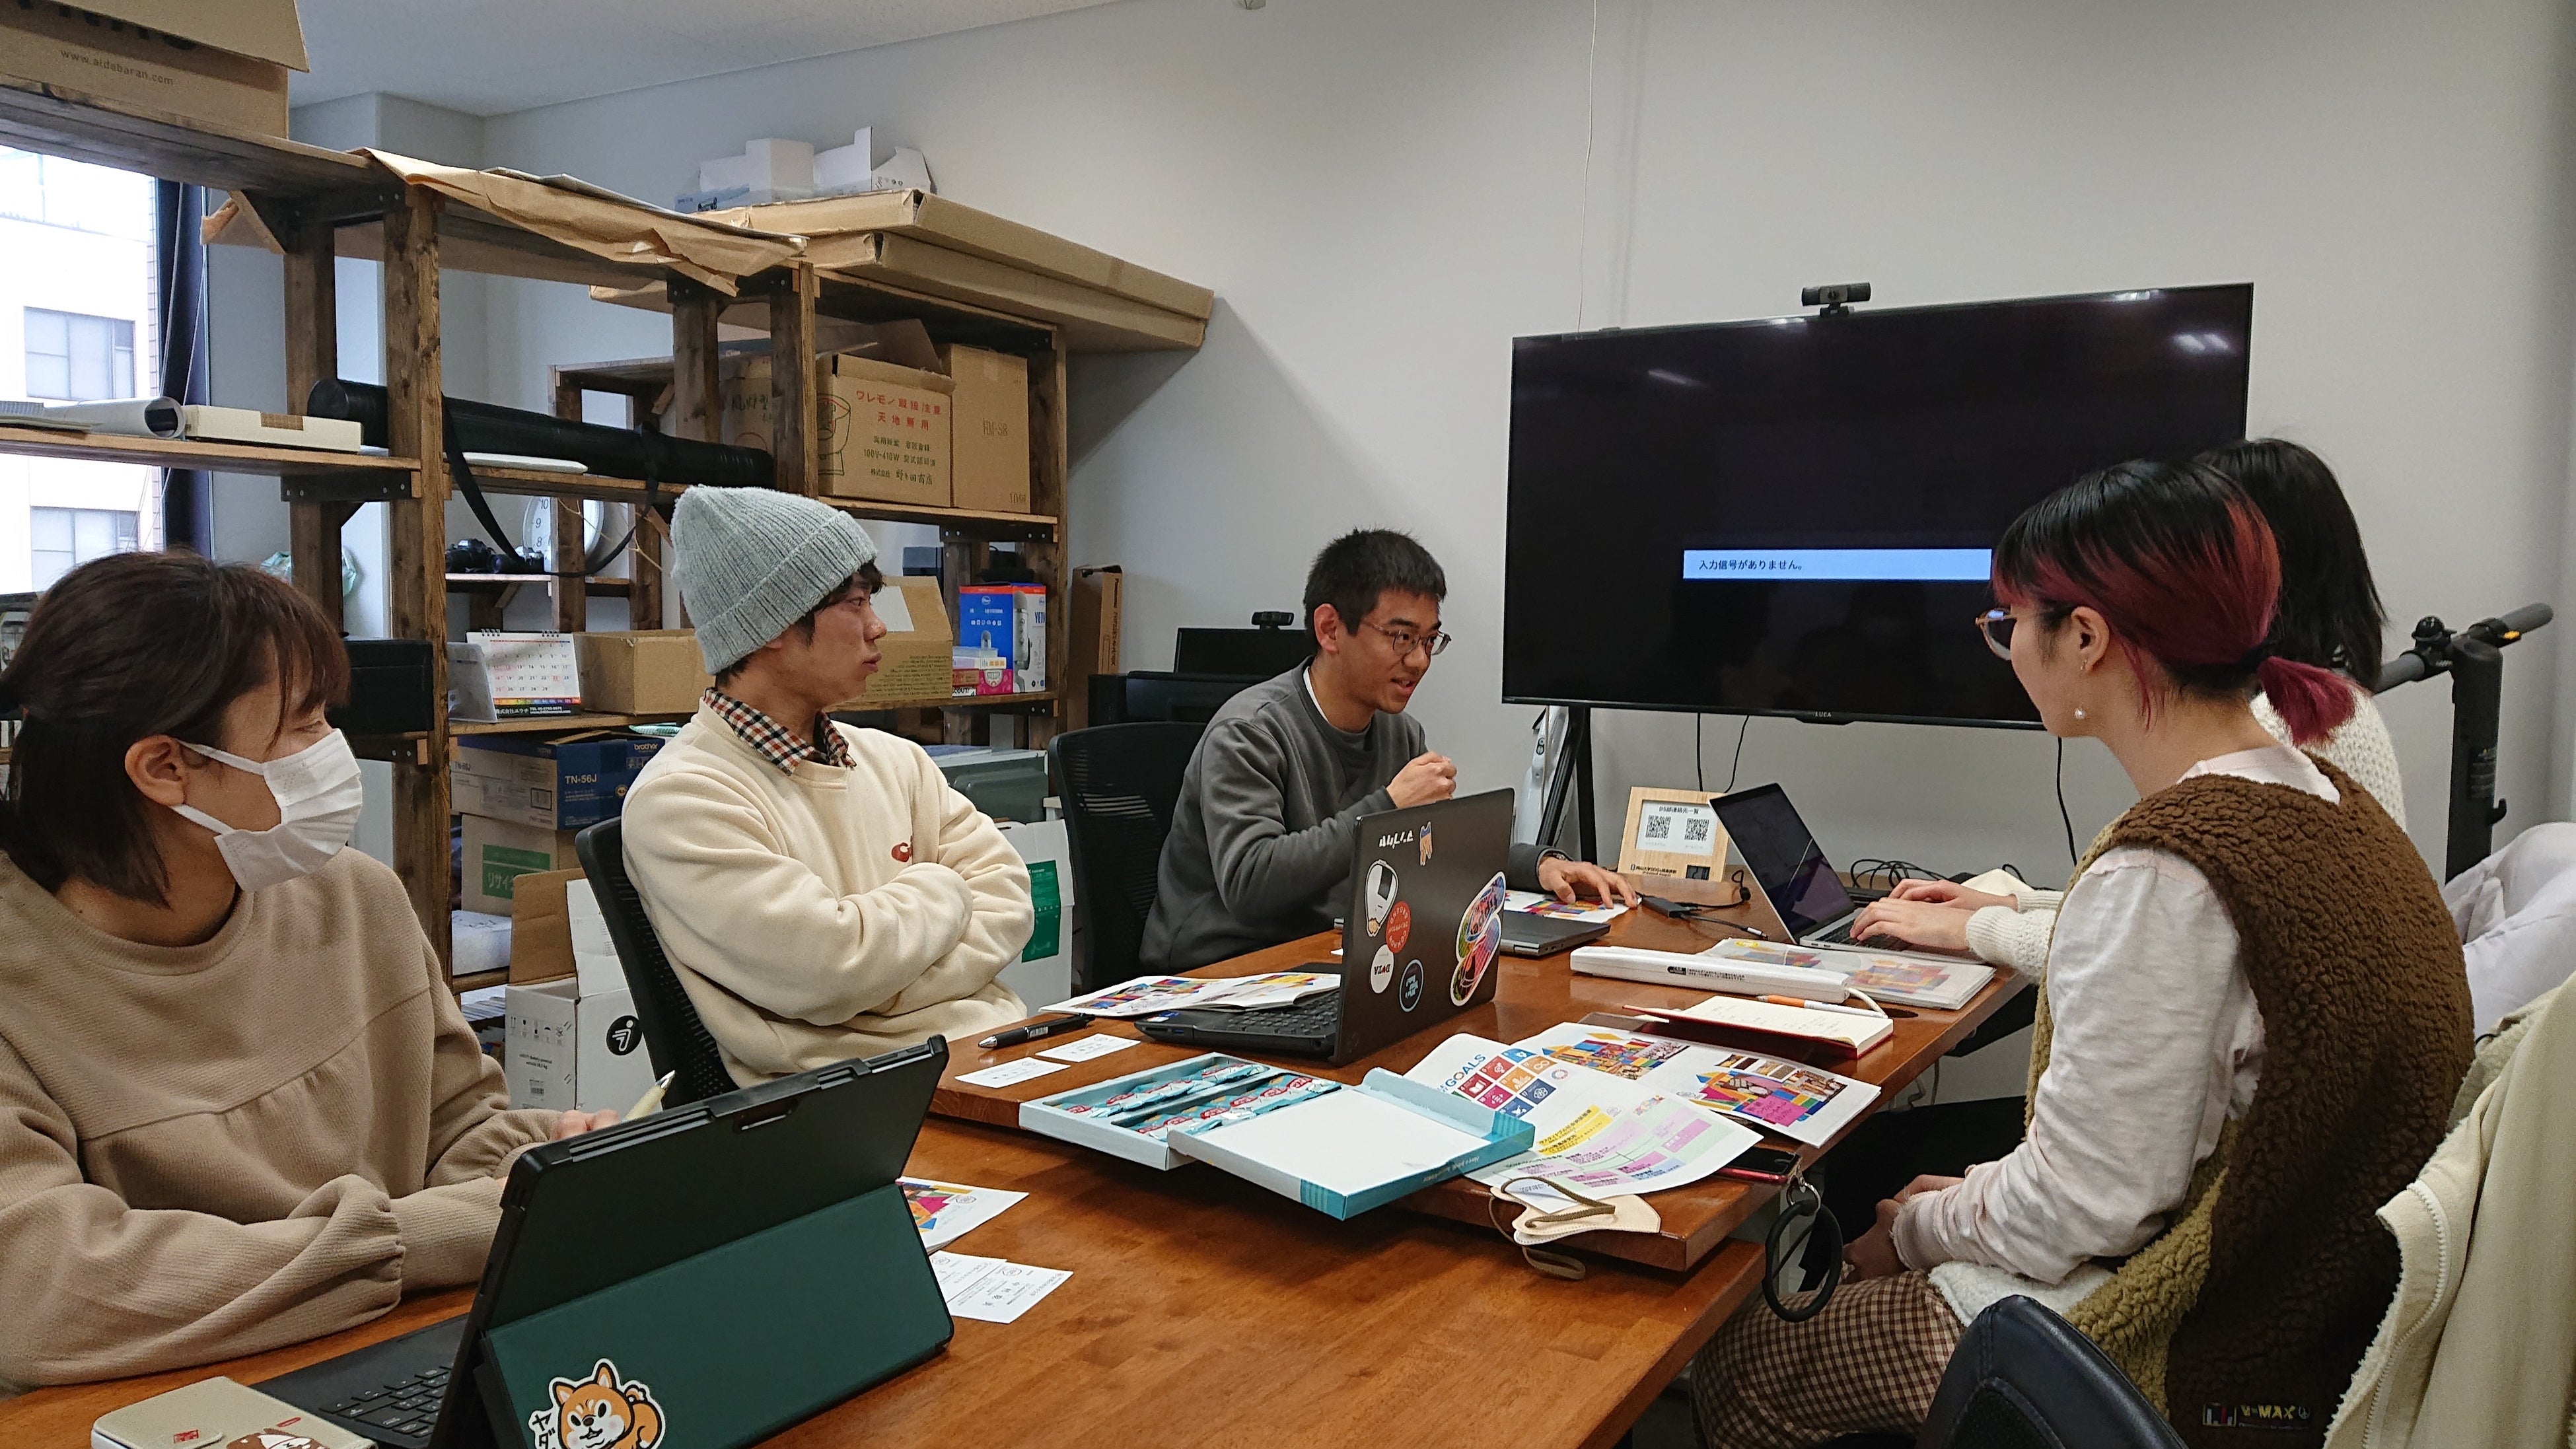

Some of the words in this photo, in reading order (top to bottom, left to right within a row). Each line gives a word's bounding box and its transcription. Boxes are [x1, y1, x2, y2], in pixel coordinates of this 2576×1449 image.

[60, 50, 174, 86] www.aldebaran.com
[878, 411, 929, 431] 天地無用
[541, 498, 549, 510] 10
[536, 517, 542, 528] 9
[536, 536, 542, 548] 8
[1698, 559, 1803, 571] 入力信号がありません。
[1034, 612, 1045, 624] YETI
[633, 742, 659, 751] brother
[565, 773, 597, 785] TN-56J
[489, 872, 514, 891] リサイ
[1445, 1054, 1486, 1087] GOALS
